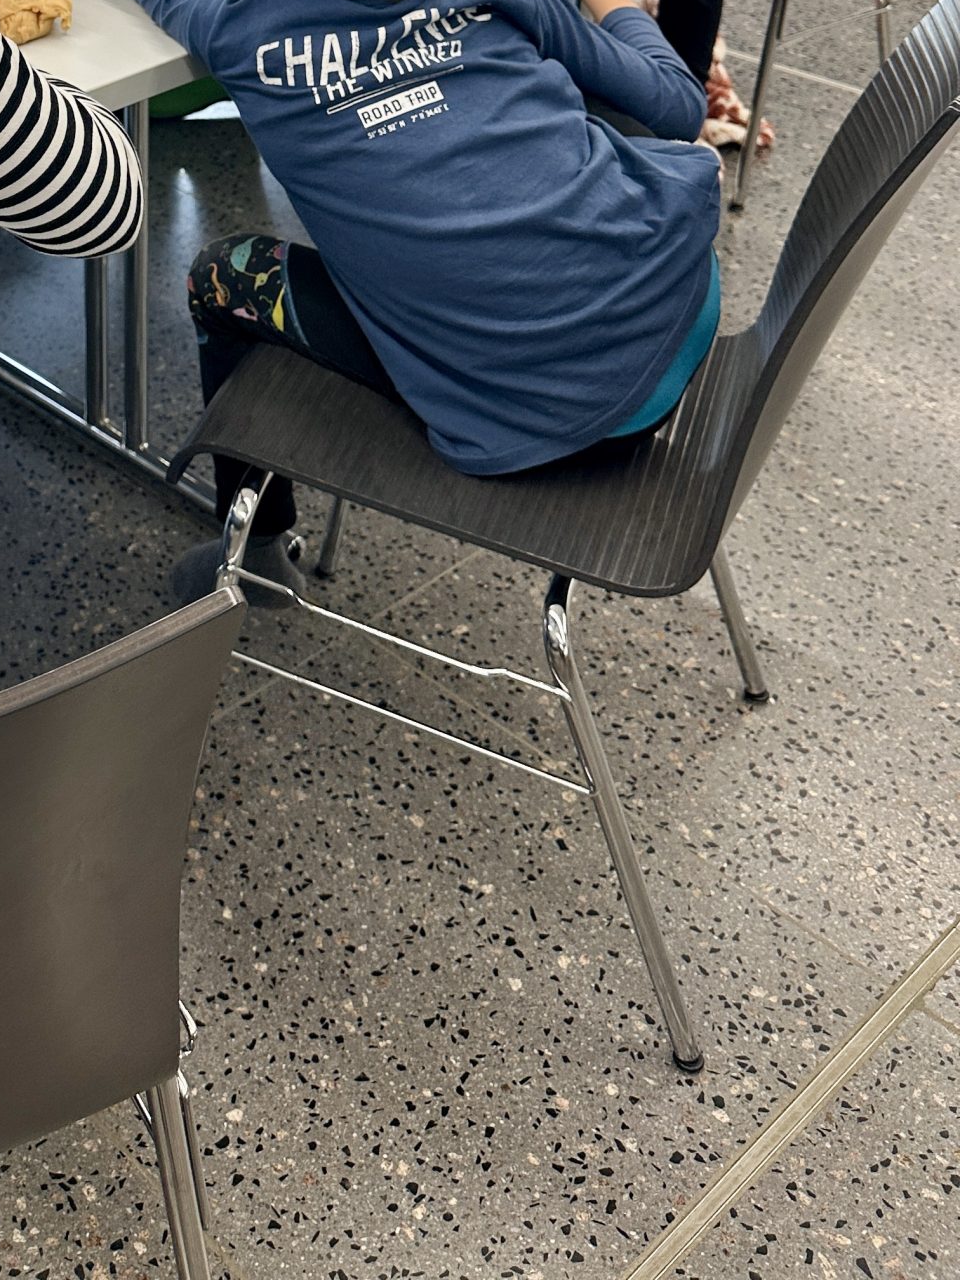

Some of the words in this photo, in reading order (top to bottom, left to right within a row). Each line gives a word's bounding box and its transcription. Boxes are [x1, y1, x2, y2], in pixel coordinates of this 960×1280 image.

[311, 77, 365, 105] THE
[361, 100, 403, 124] ROAD
[405, 86, 438, 107] TRIP
